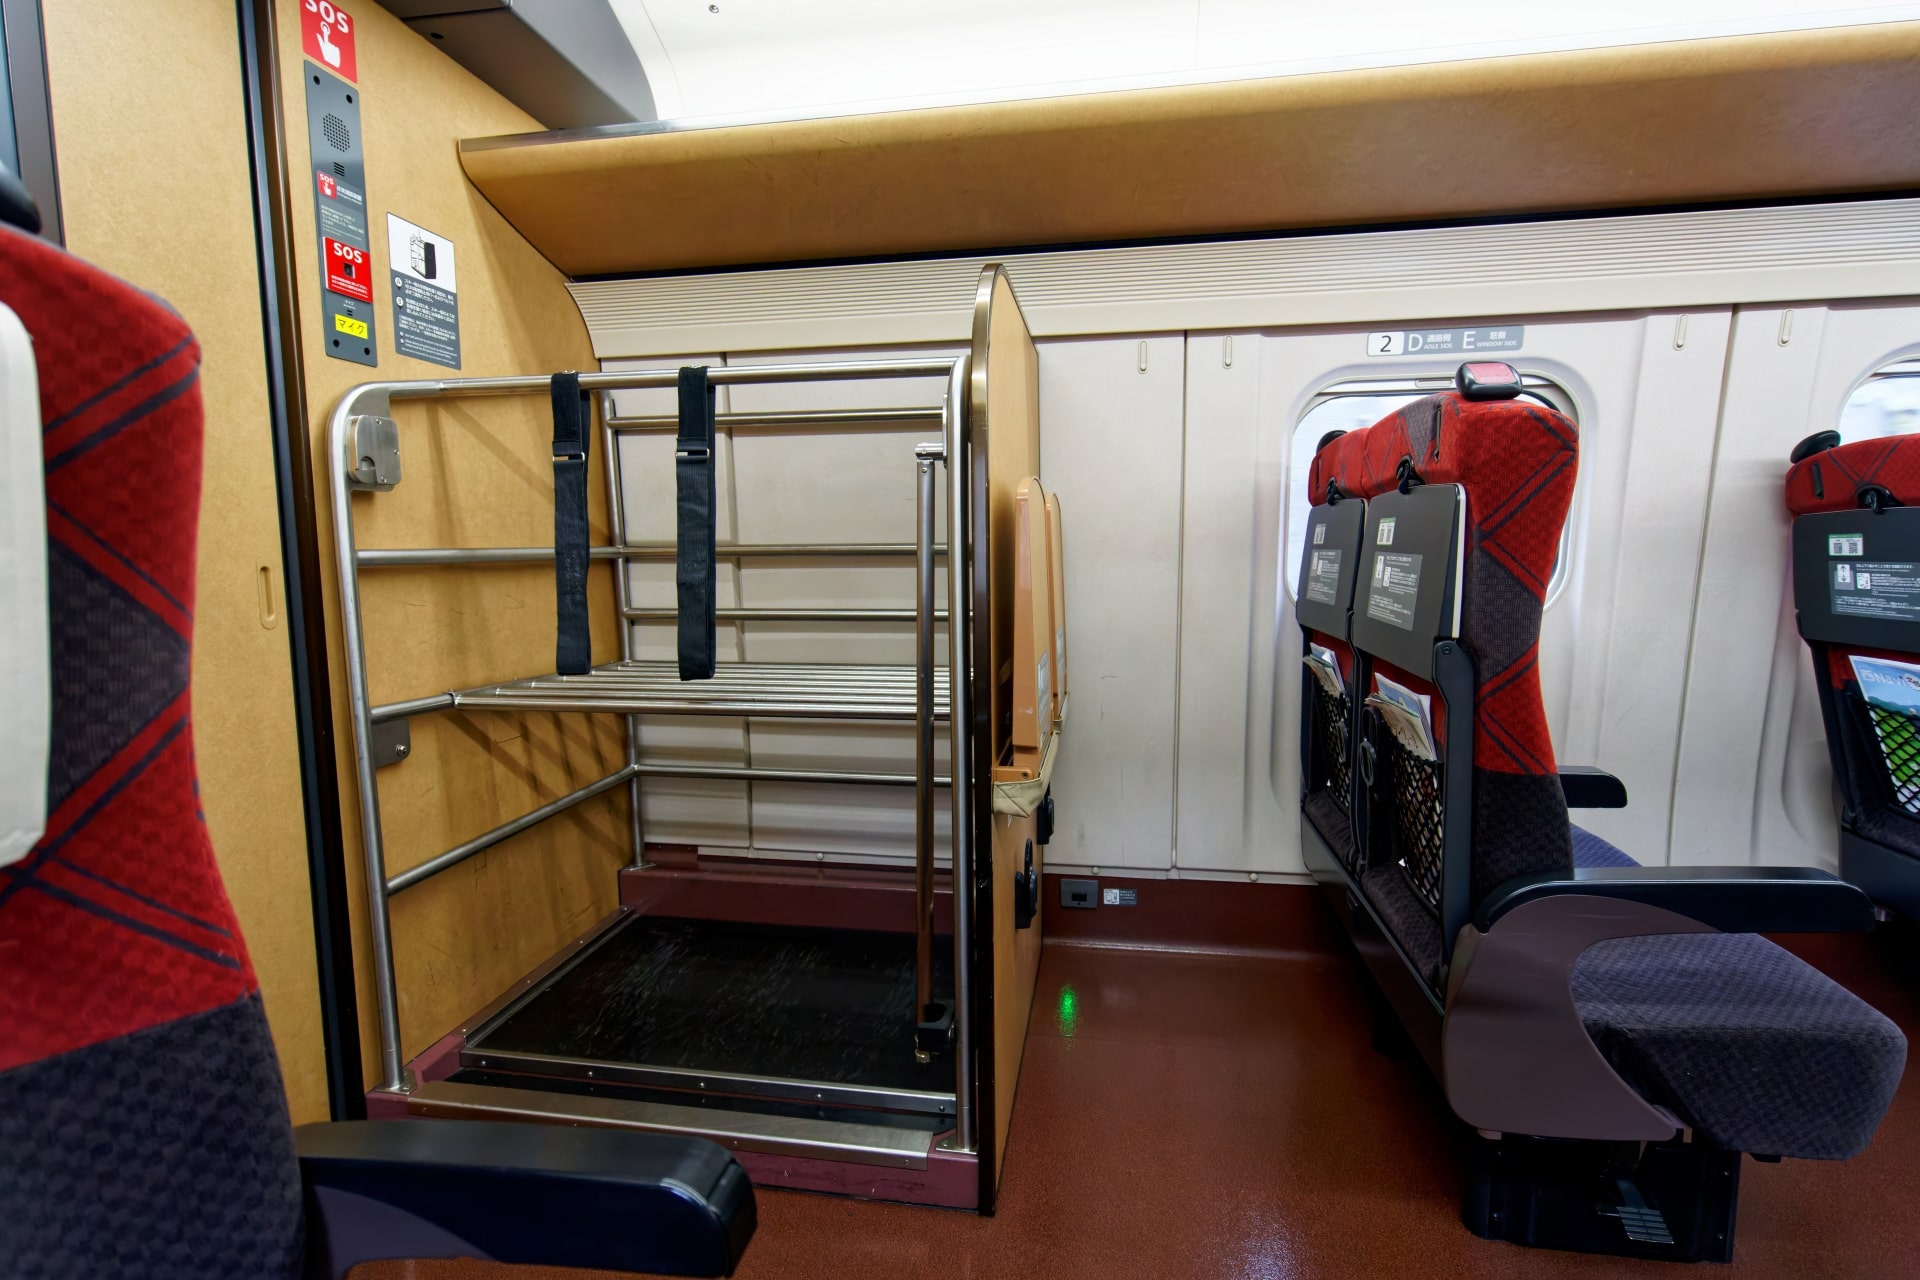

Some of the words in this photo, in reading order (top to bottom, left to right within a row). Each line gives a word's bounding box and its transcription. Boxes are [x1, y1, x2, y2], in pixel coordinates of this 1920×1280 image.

[319, 173, 334, 185] SOS
[333, 242, 362, 264] SOS
[338, 318, 364, 334] マイク
[1379, 335, 1392, 352] 2
[1408, 333, 1423, 351] D
[1463, 331, 1476, 349] E
